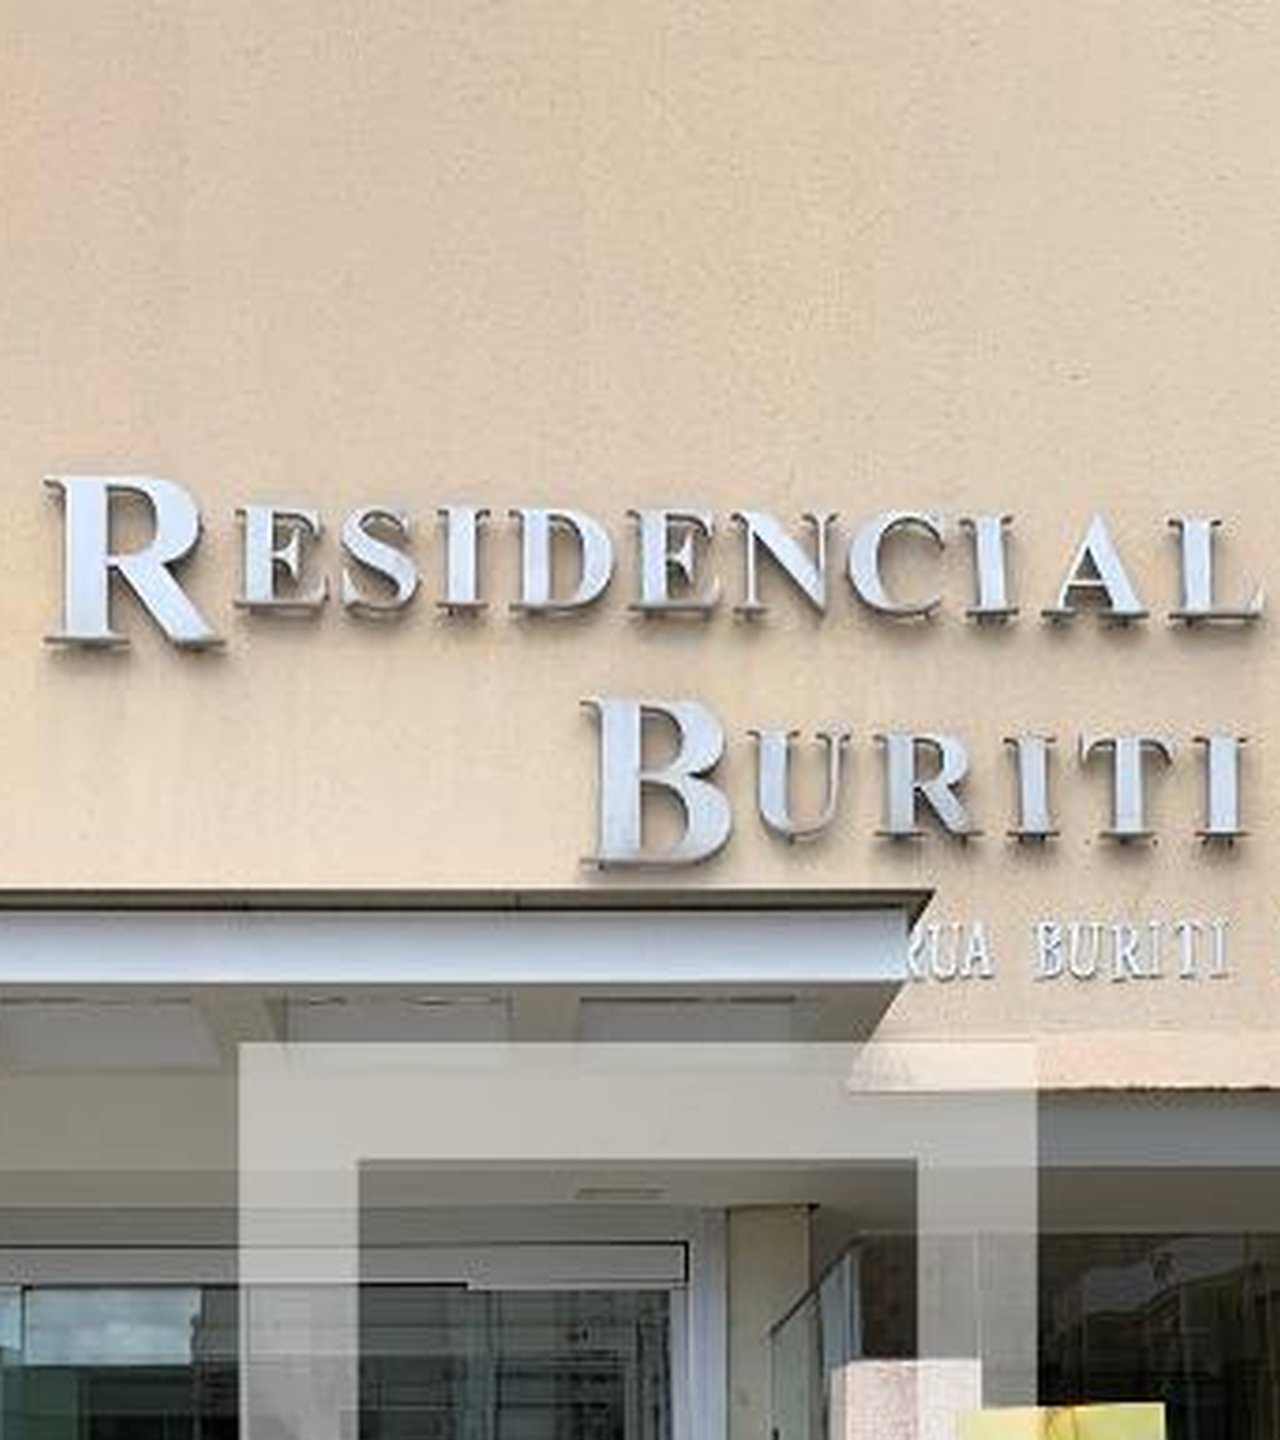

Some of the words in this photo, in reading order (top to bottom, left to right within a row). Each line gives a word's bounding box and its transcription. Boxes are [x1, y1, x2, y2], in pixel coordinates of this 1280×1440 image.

[42, 474, 1266, 654] RESIDENCIAL
[580, 696, 1253, 872] BURITI
[1034, 918, 1232, 982] BURITI
